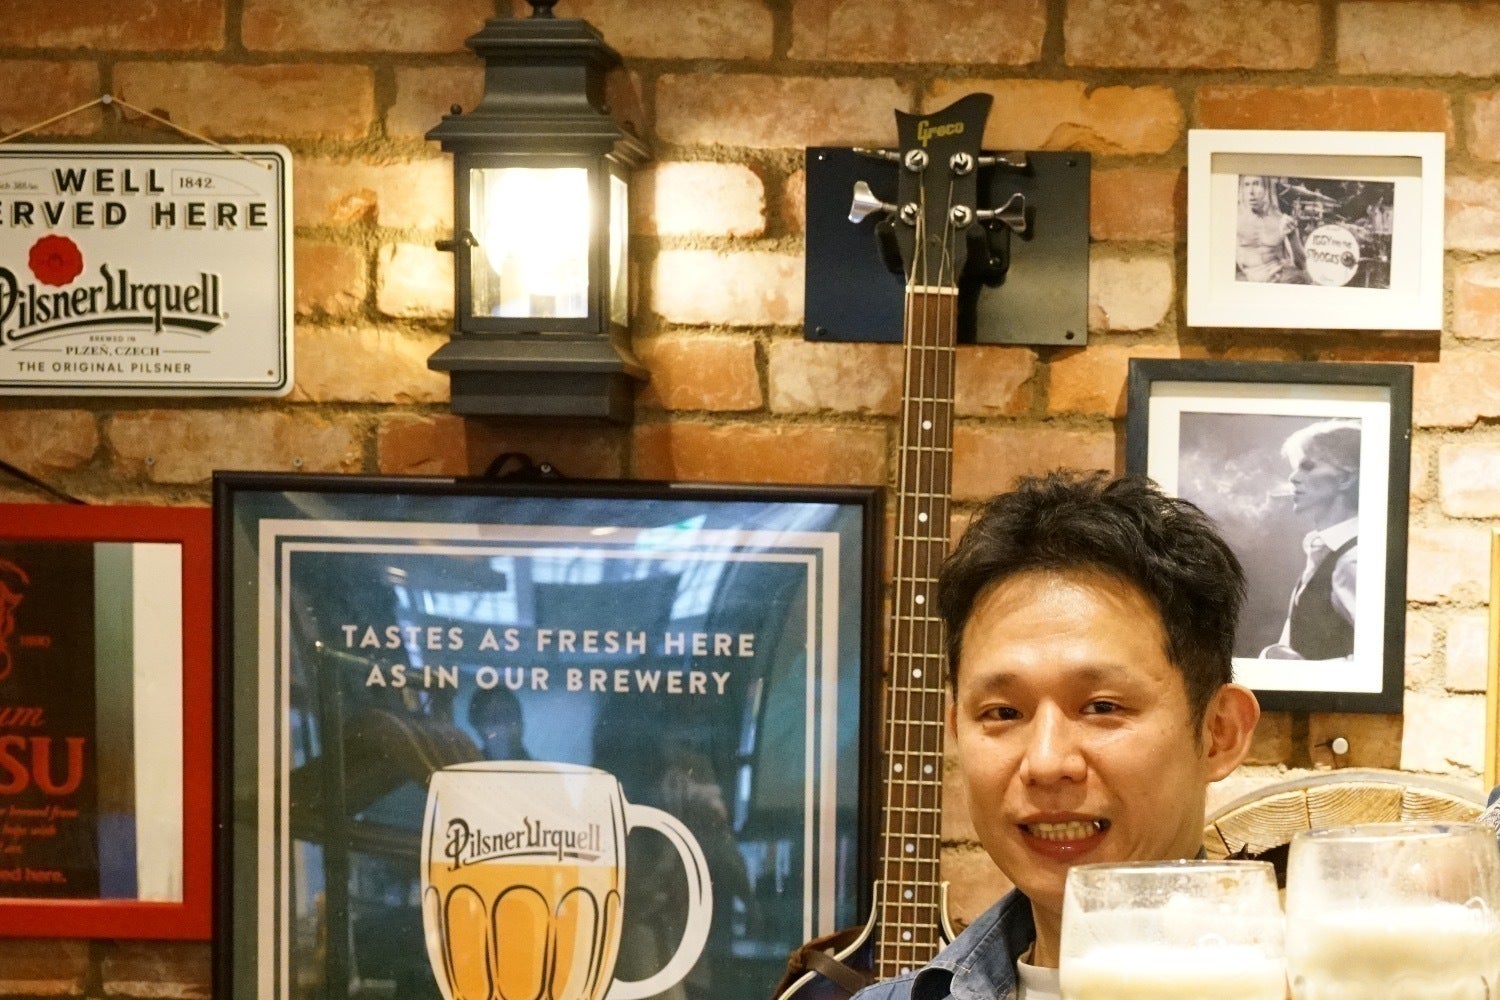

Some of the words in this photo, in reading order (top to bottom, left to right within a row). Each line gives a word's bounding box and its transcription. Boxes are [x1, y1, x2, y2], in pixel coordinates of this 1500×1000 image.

[917, 120, 964, 147] Greco
[53, 168, 165, 195] WELL
[0, 201, 128, 227] RVED
[152, 202, 268, 228] HERE
[100, 263, 222, 335] Urquell
[114, 346, 160, 356] CZECH
[19, 361, 45, 373] THE
[52, 362, 124, 373] ORIGINAL
[131, 362, 192, 374] PILSNER
[341, 624, 465, 652] TASTES
[480, 627, 521, 652] AS
[537, 629, 648, 655] FRESH
[664, 632, 756, 658] HERE
[365, 664, 407, 689] AS
[423, 665, 458, 690] IN
[475, 666, 549, 692] OUR
[566, 669, 732, 696] BREWERY
[445, 818, 528, 872] Pilsner
[524, 815, 602, 863] Urquell
